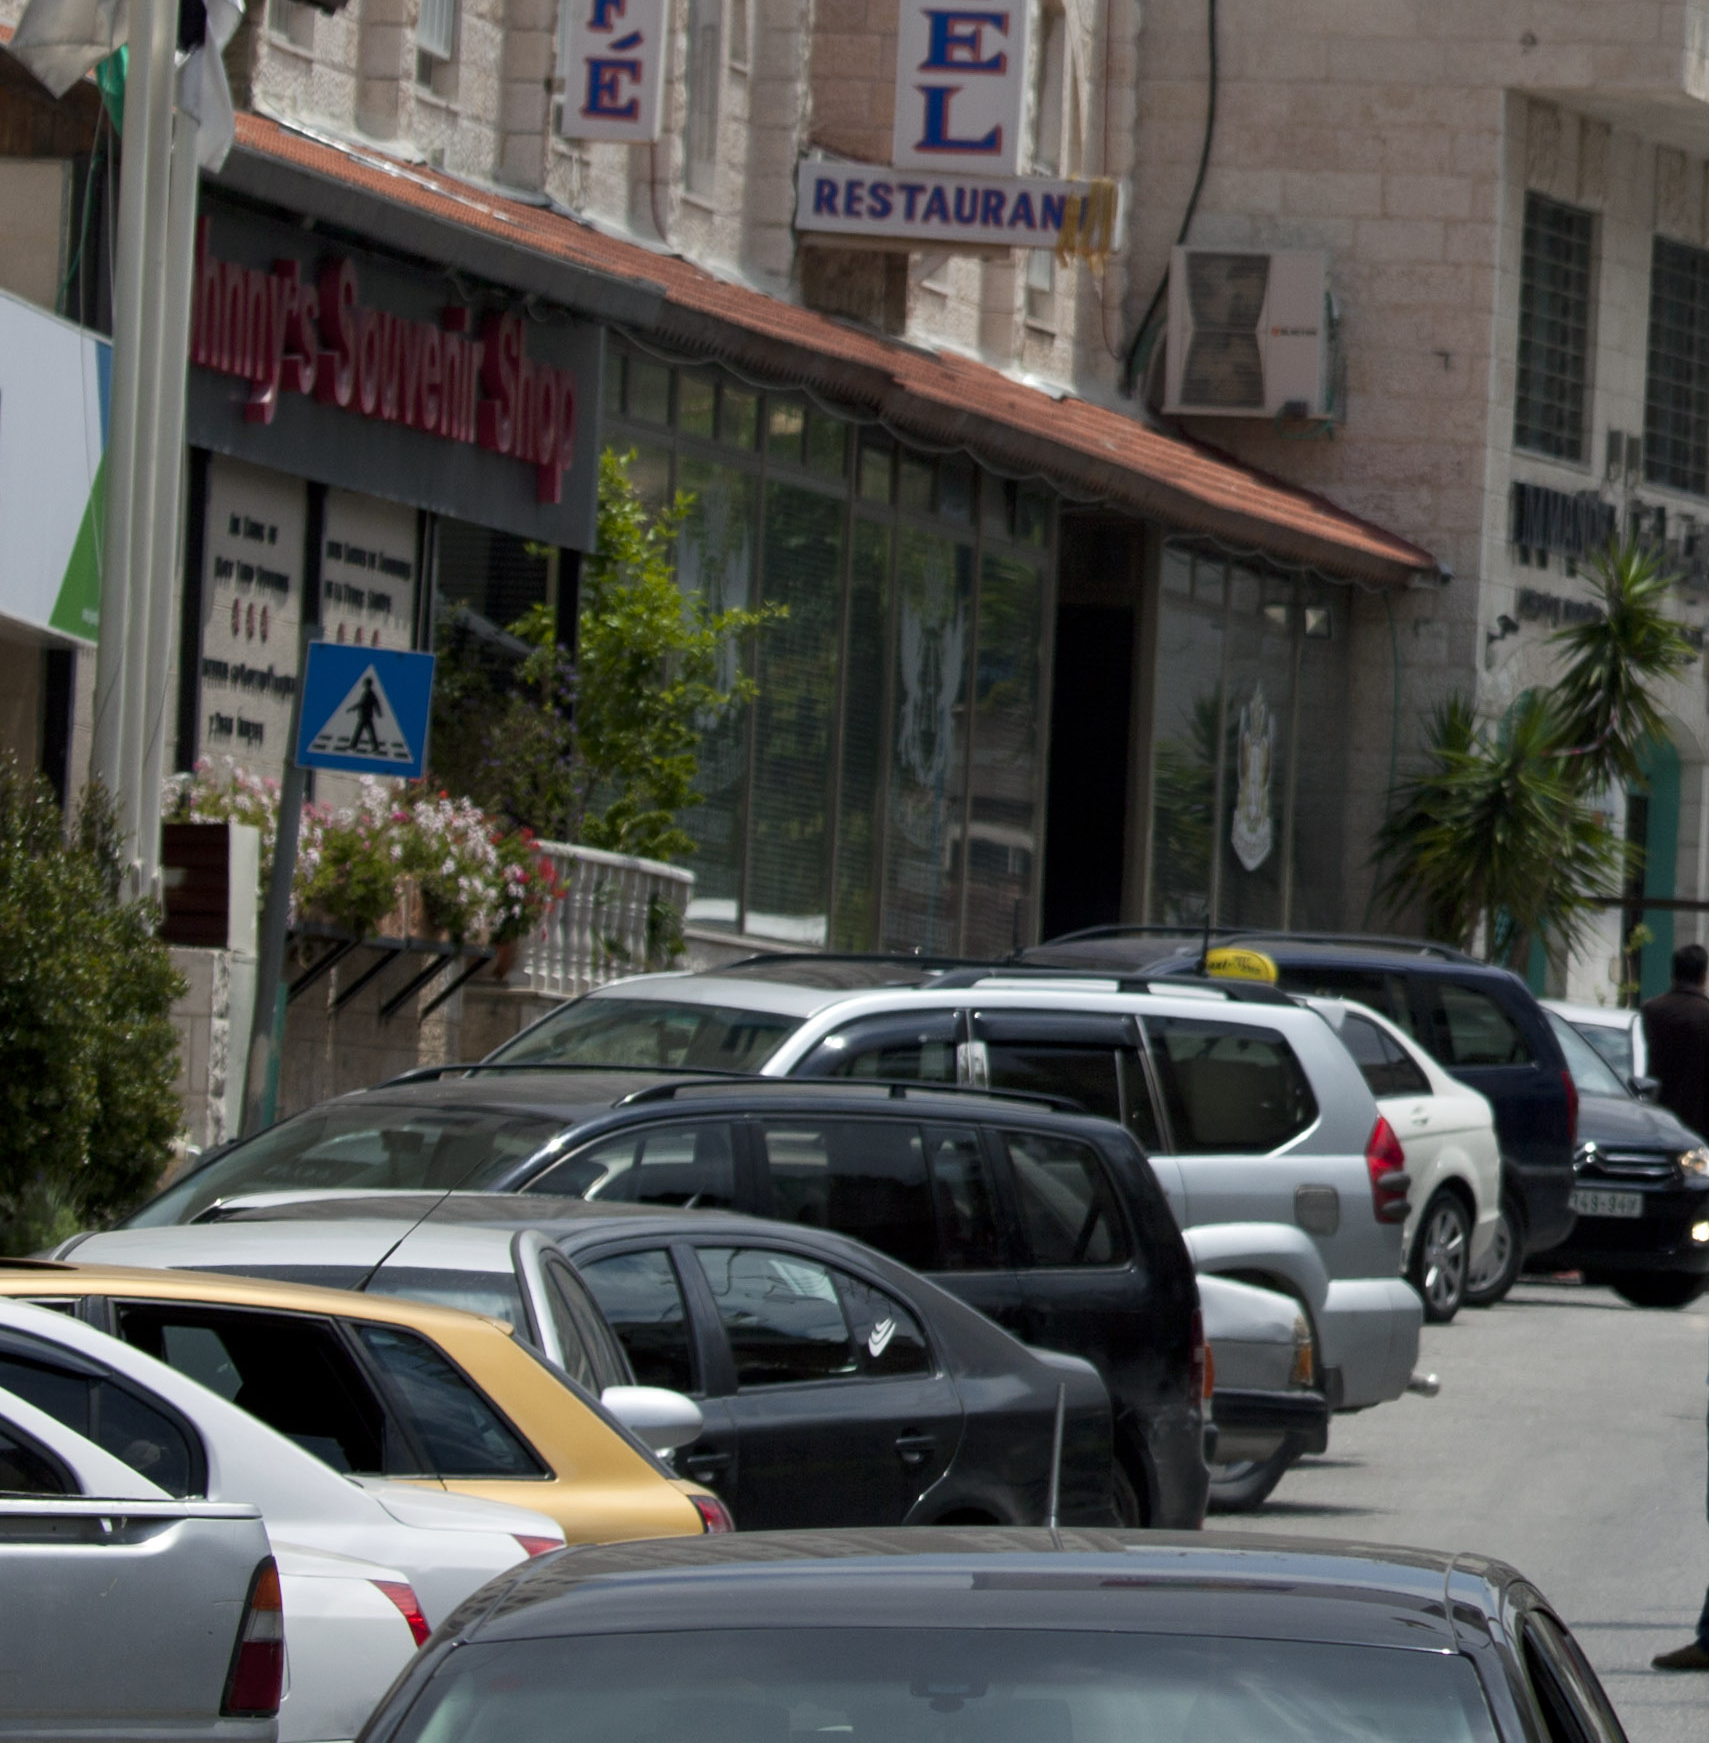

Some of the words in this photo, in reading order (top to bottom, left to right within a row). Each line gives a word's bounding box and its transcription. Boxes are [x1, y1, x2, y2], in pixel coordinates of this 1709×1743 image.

[192, 215, 320, 425] hnny's
[315, 254, 486, 446] Souvenir
[477, 307, 579, 504] Shop
